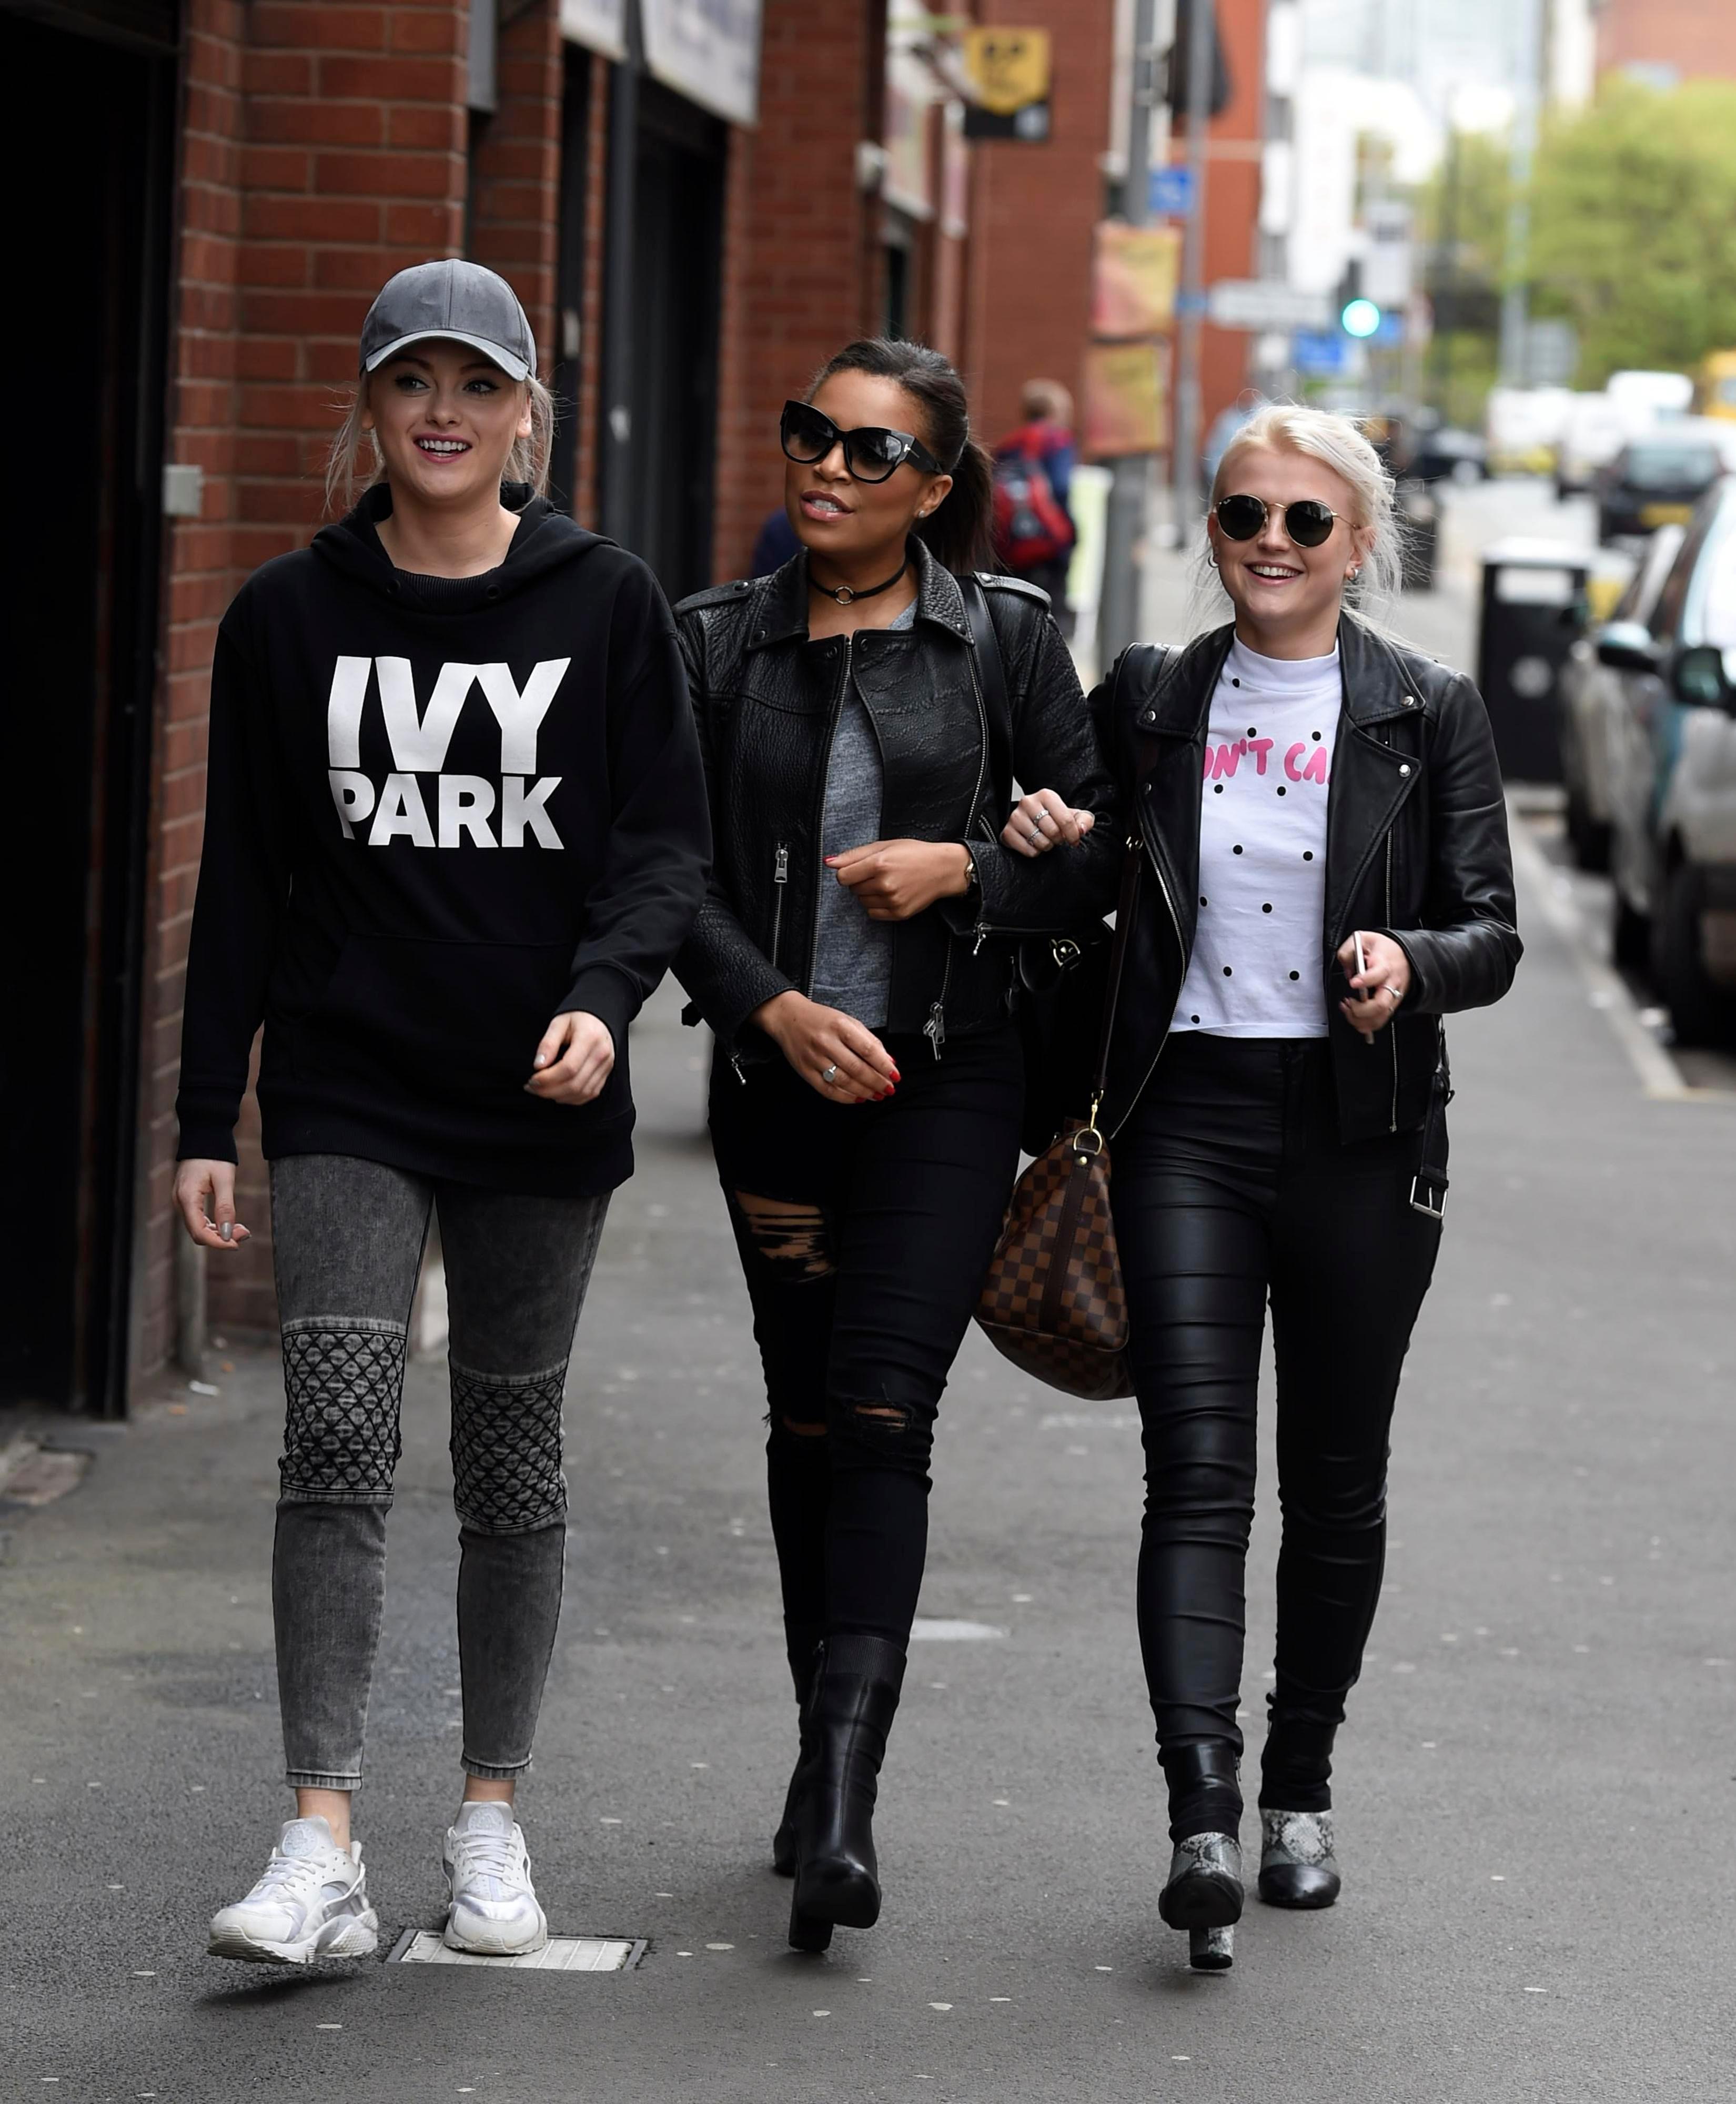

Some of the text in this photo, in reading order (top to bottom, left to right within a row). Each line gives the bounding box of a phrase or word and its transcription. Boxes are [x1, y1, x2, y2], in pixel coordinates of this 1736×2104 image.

[328, 656, 571, 774] IVY
[1284, 743, 1330, 784] CA
[328, 770, 564, 849] PARK
